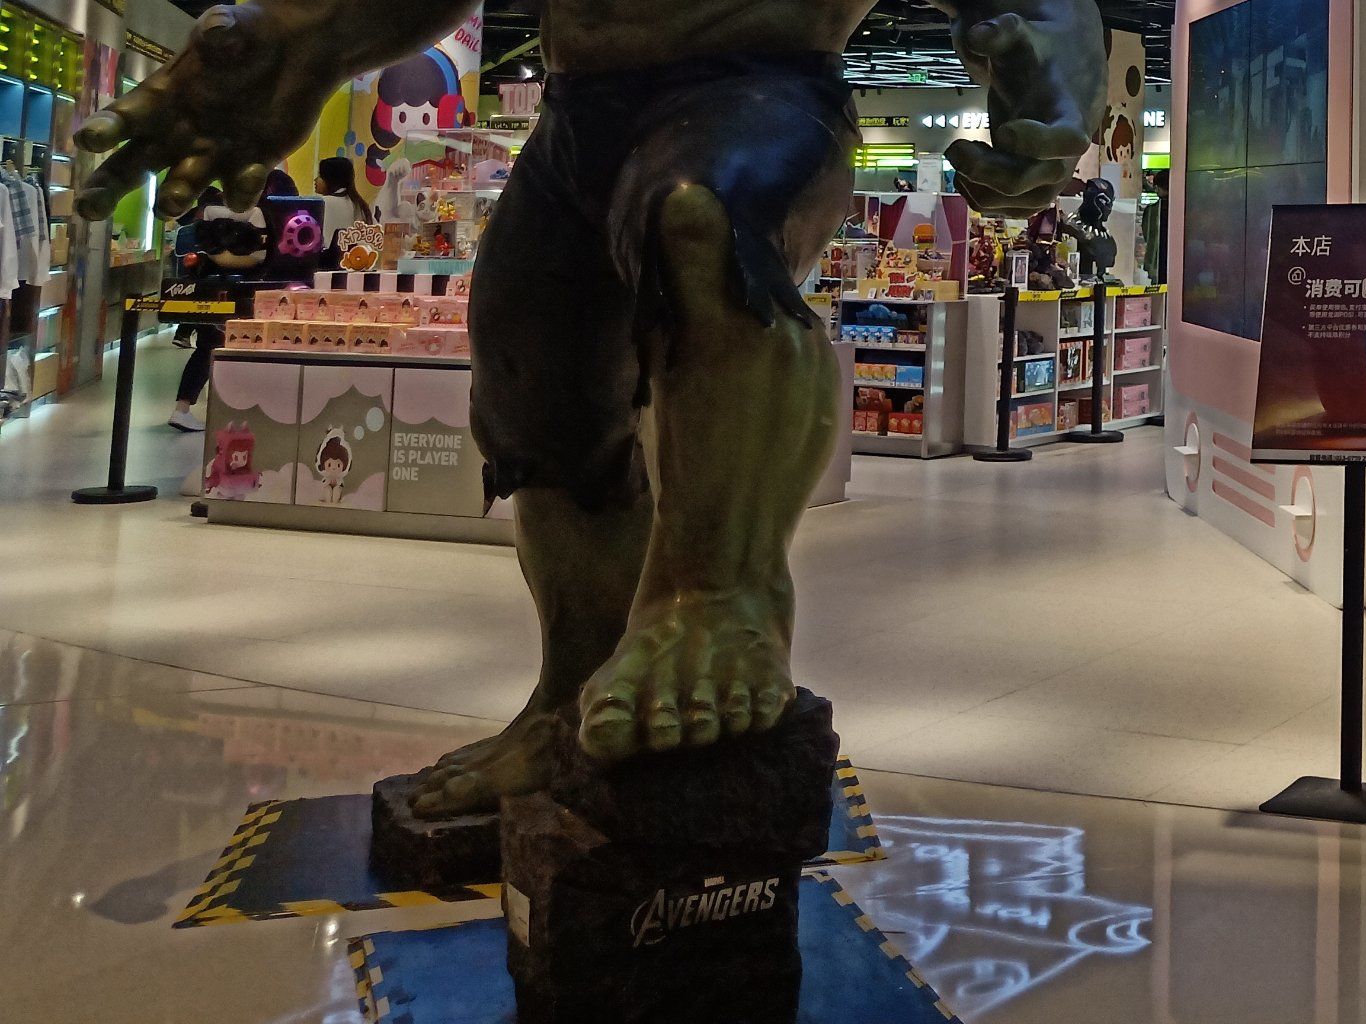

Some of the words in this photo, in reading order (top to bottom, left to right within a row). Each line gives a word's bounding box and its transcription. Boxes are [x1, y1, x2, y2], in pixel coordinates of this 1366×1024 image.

[498, 82, 542, 115] TOP
[1289, 234, 1332, 257] 本店
[394, 432, 463, 449] EVERYONE
[393, 449, 406, 464] IS
[408, 449, 459, 466] PLAYER
[392, 466, 420, 481] ONE
[630, 877, 780, 948] AVENGERS
